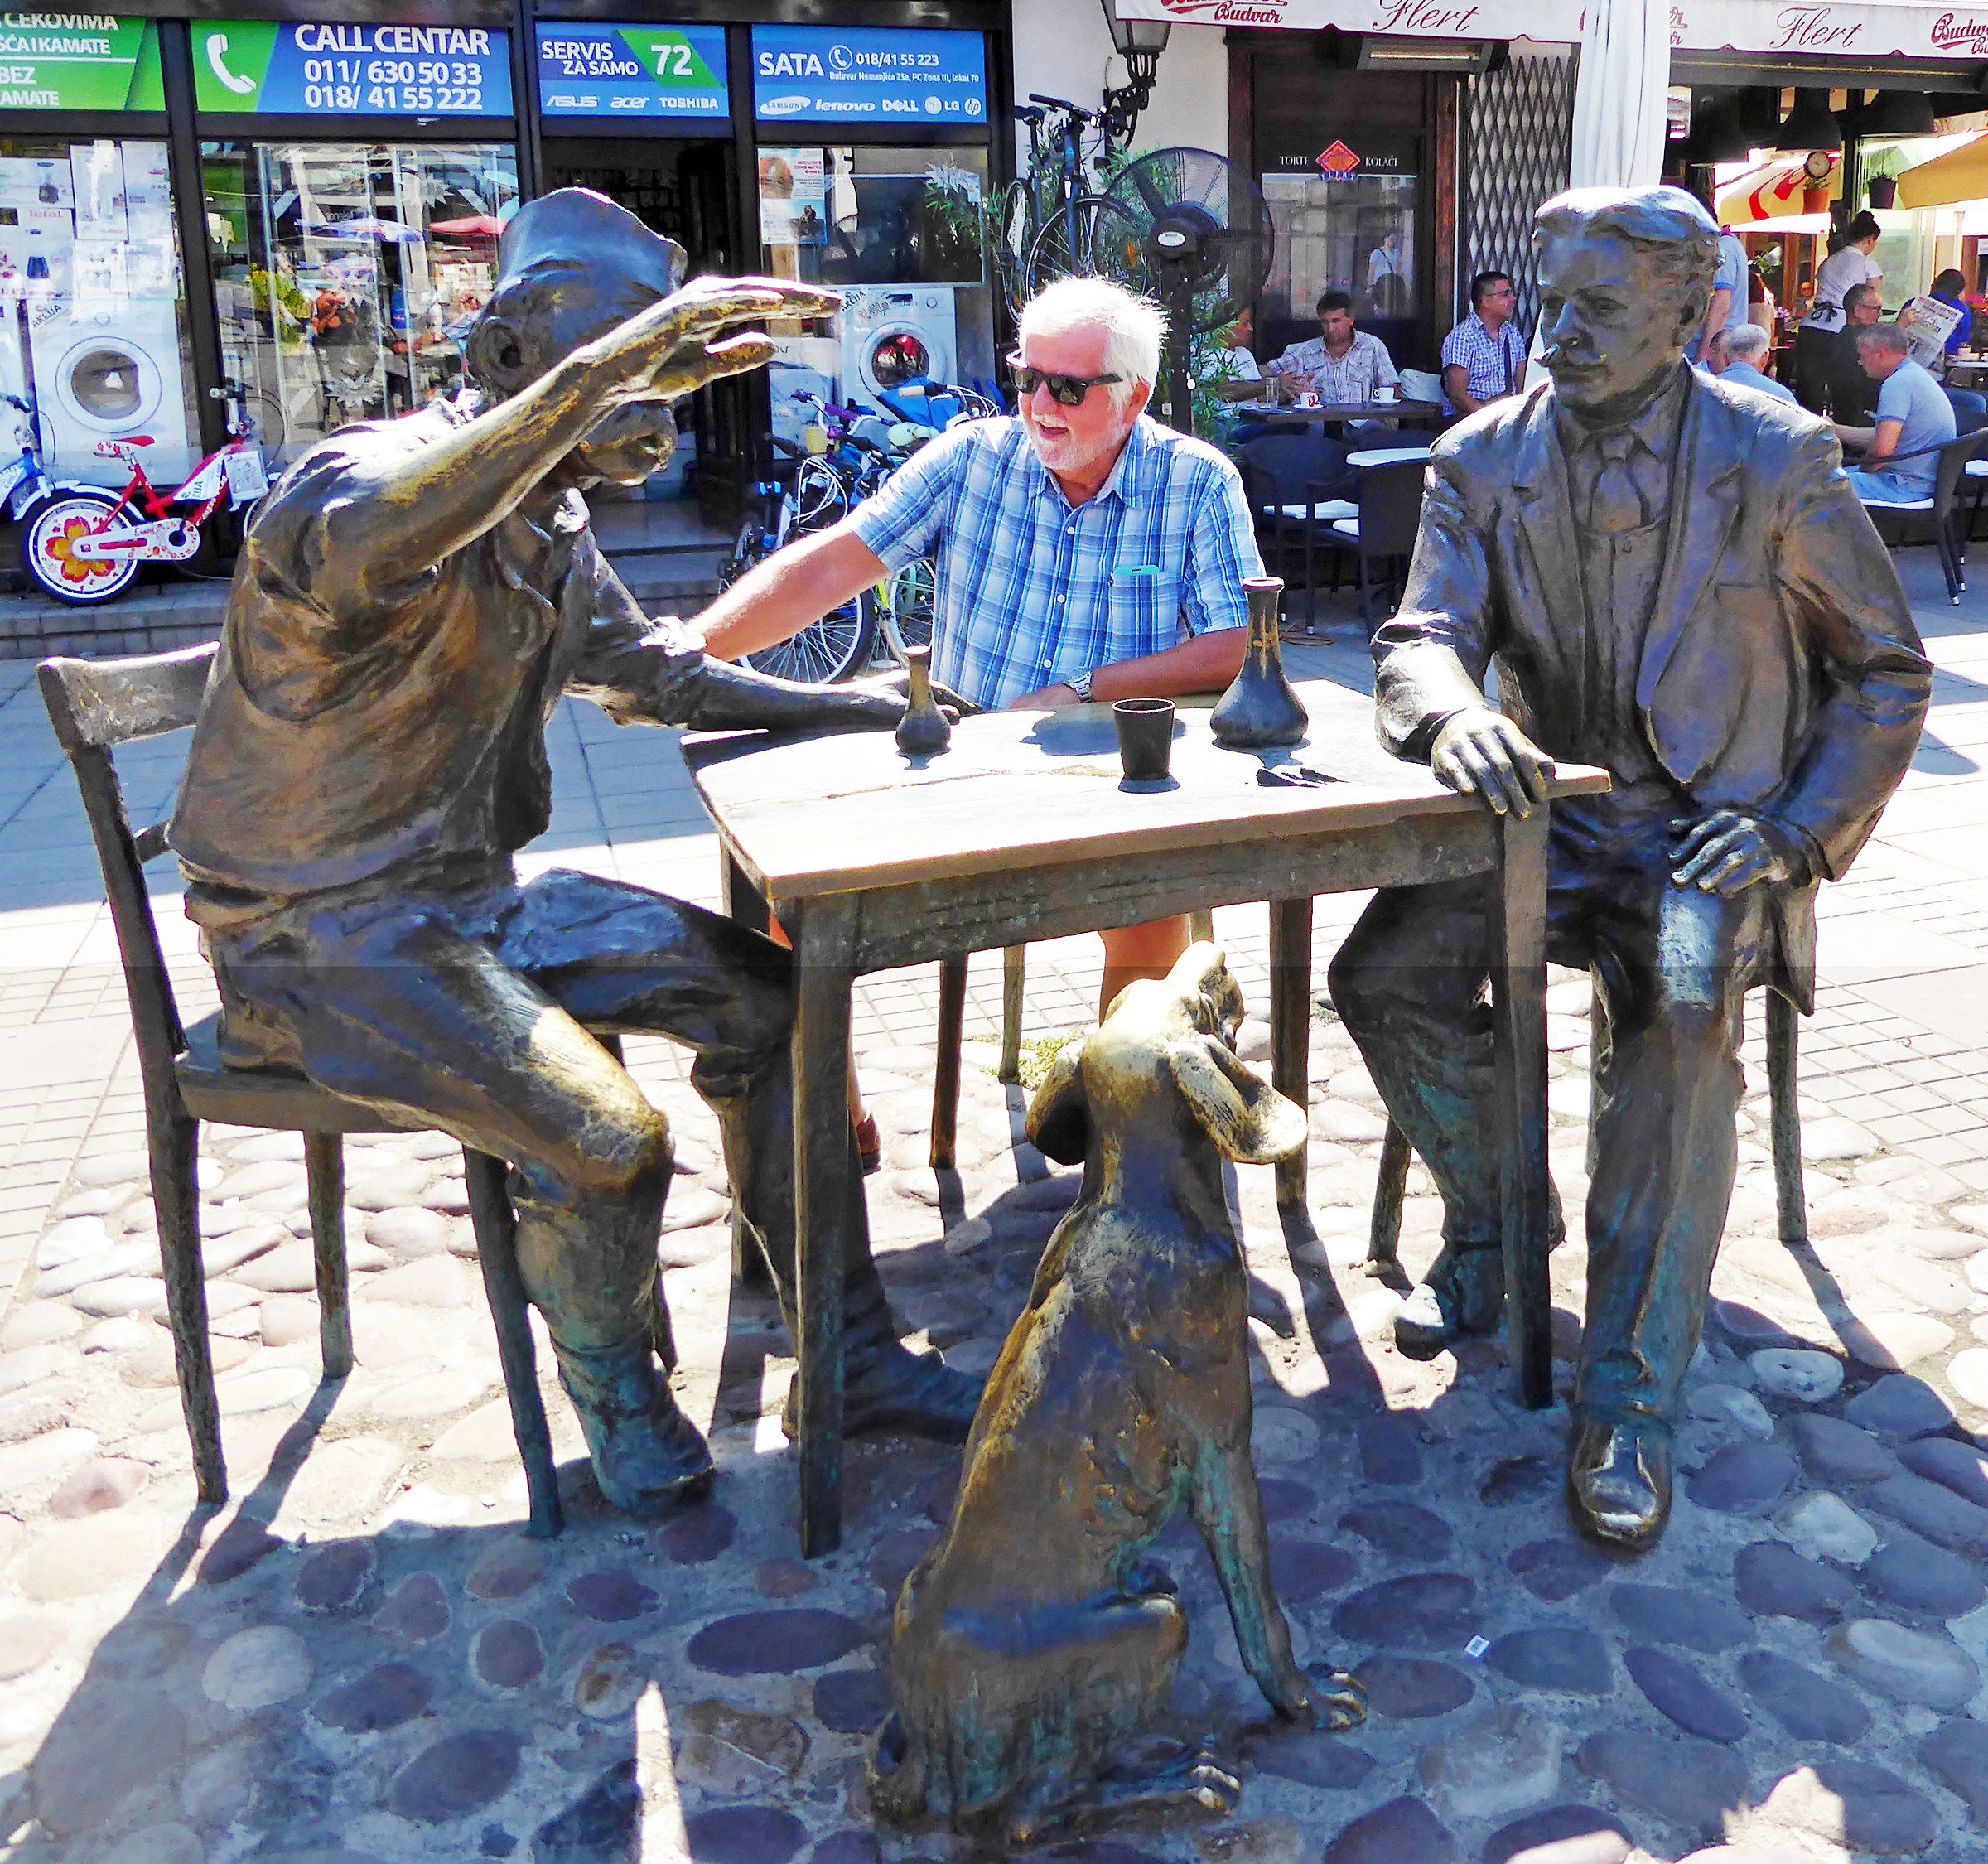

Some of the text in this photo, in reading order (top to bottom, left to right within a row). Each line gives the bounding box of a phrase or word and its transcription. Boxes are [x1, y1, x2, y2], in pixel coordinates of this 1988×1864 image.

[1214, 1, 1282, 23] Budvar
[1373, 0, 1480, 32] Flert
[1771, 7, 1863, 48] Flert
[41, 37, 111, 55] KAMATE
[295, 24, 491, 56] CALL CENTAR
[542, 41, 614, 60] SERVIS
[651, 44, 693, 76] 72
[856, 52, 939, 68] 018/41 55 223
[304, 60, 483, 85] 011/ 630 50 33
[563, 60, 639, 76] ZA SAMO
[759, 52, 825, 76] SATA
[829, 71, 857, 81] Bulevar
[0, 90, 60, 106] AMATE
[304, 85, 483, 110] 018/ 41 55 222
[546, 95, 719, 109] ASUS acer TOSHIBA
[815, 99, 876, 112] lenovo
[882, 99, 919, 113] DELL
[945, 99, 960, 111] LG
